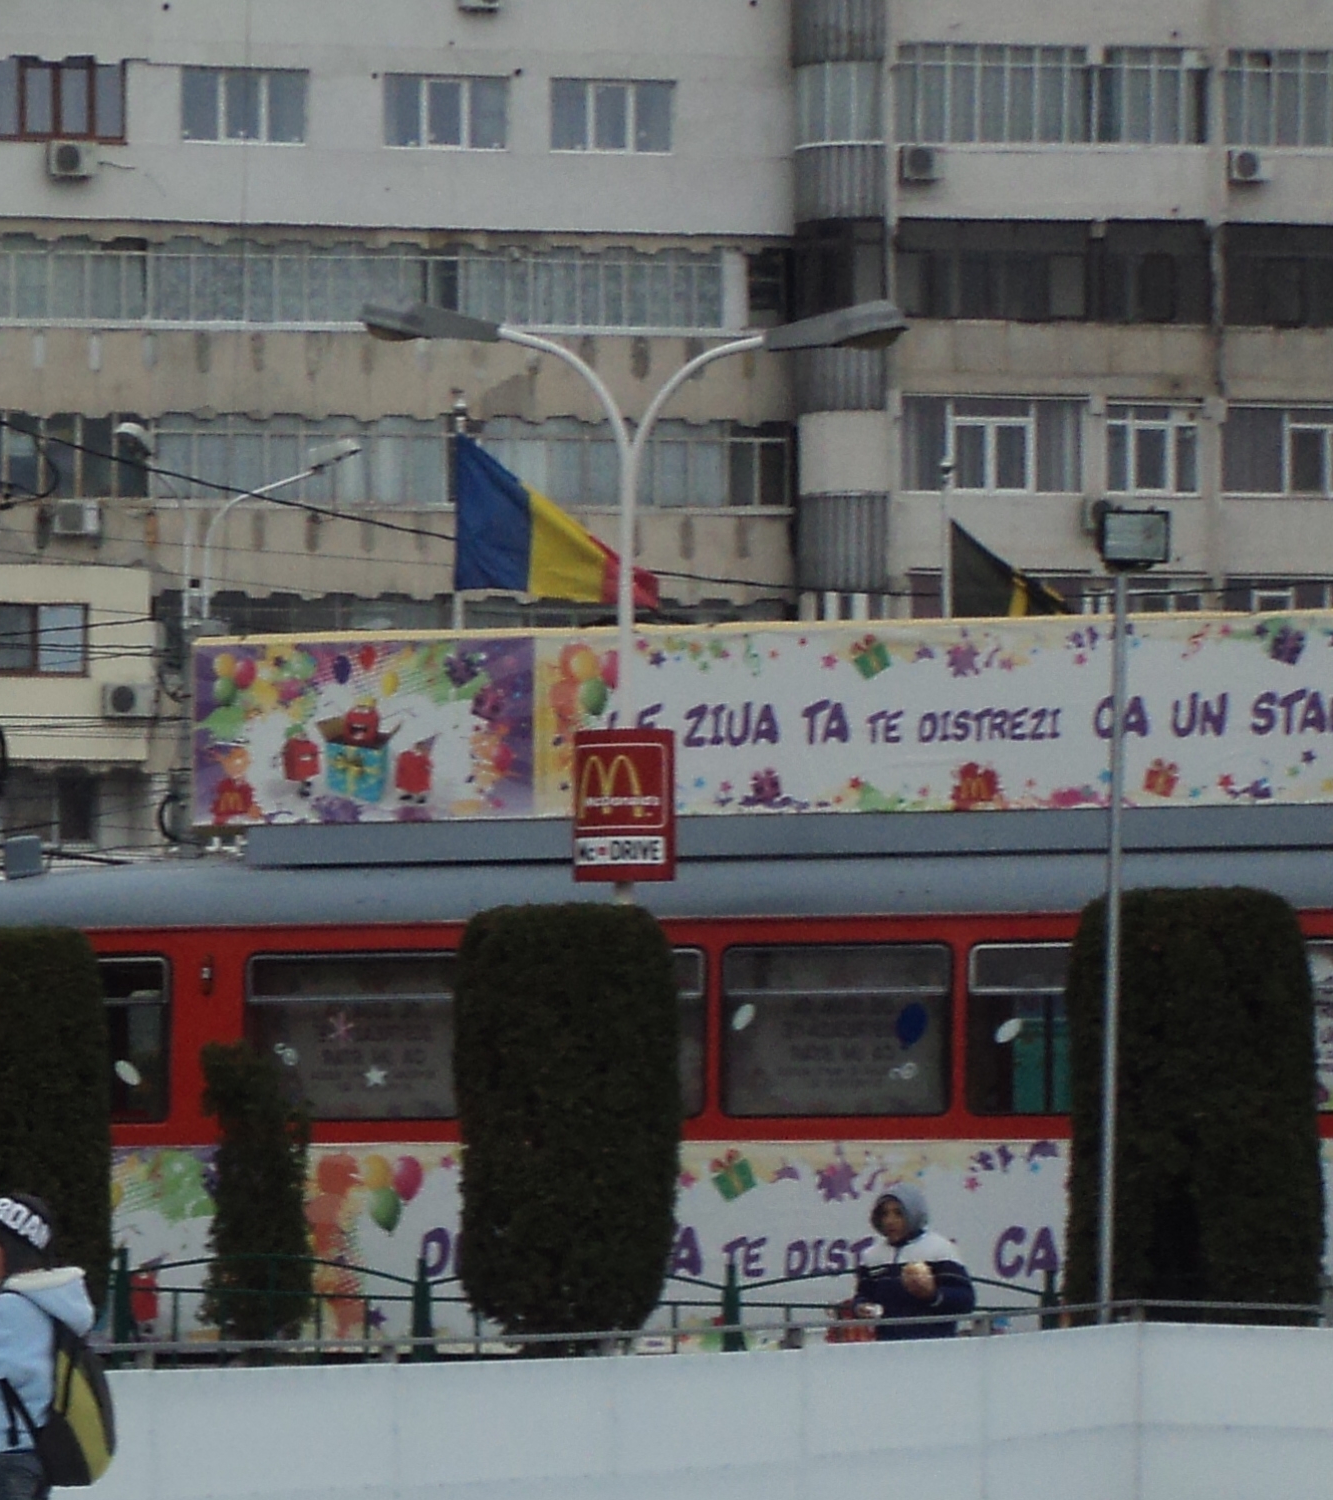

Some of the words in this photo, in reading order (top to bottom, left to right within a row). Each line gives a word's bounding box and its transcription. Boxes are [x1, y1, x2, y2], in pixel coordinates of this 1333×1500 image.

[683, 701, 779, 747] ZIUA
[801, 699, 850, 745] TA
[867, 709, 904, 744] TE
[917, 707, 1062, 743] DISTREZI
[1093, 696, 1149, 740] CA
[1171, 692, 1228, 738] UN
[1250, 688, 1333, 736] STA
[610, 840, 660, 861] DRIVE
[723, 1236, 767, 1277] TE
[994, 1225, 1058, 1278] CA
